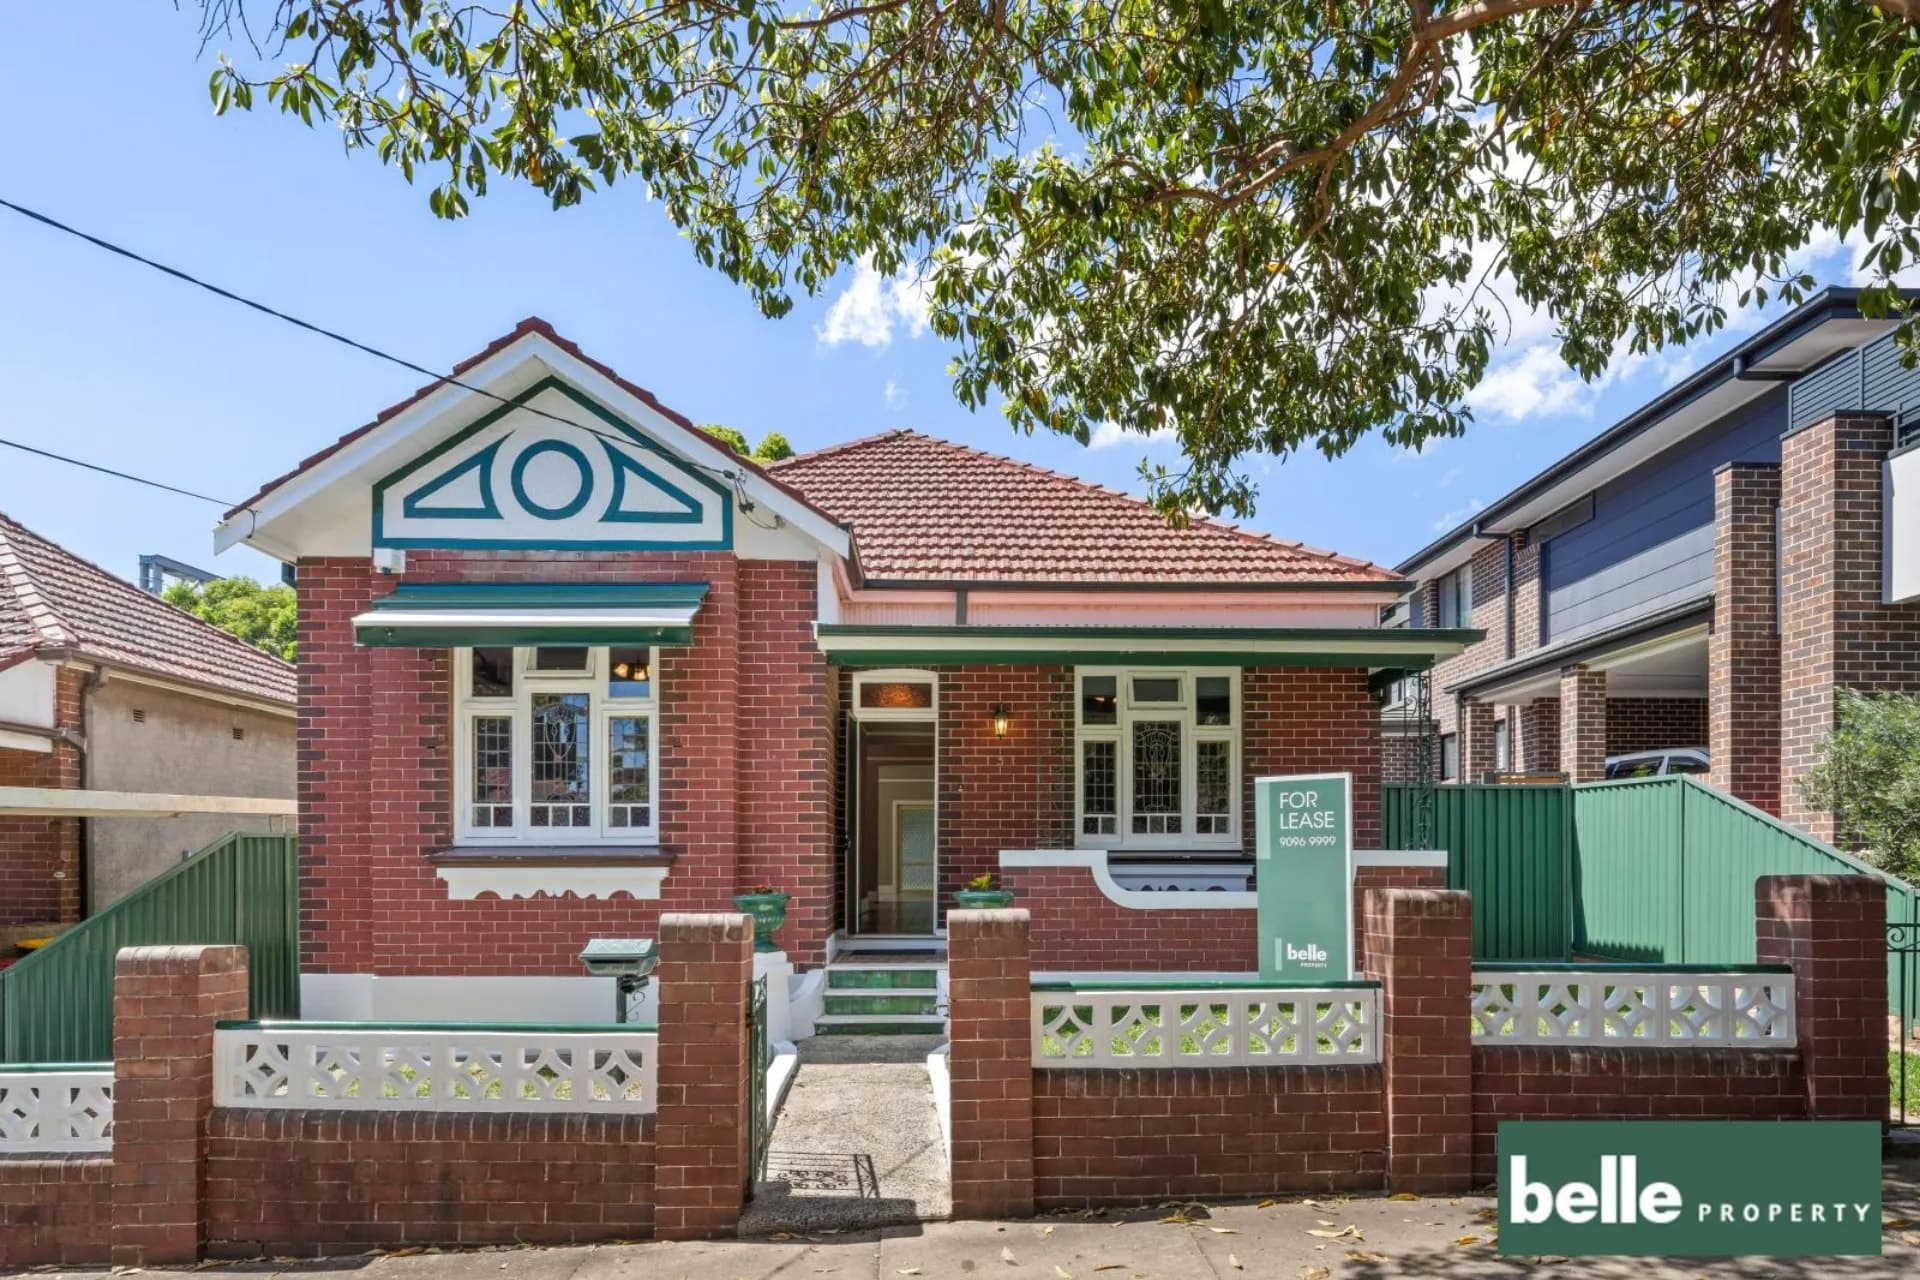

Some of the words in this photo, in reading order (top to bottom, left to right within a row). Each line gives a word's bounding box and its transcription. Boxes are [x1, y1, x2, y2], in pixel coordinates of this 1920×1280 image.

[1279, 791, 1318, 809] FOR
[1279, 811, 1335, 829] LEASE
[1279, 836, 1306, 847] 9096
[1308, 836, 1336, 847] 9999
[1287, 943, 1327, 961] belle
